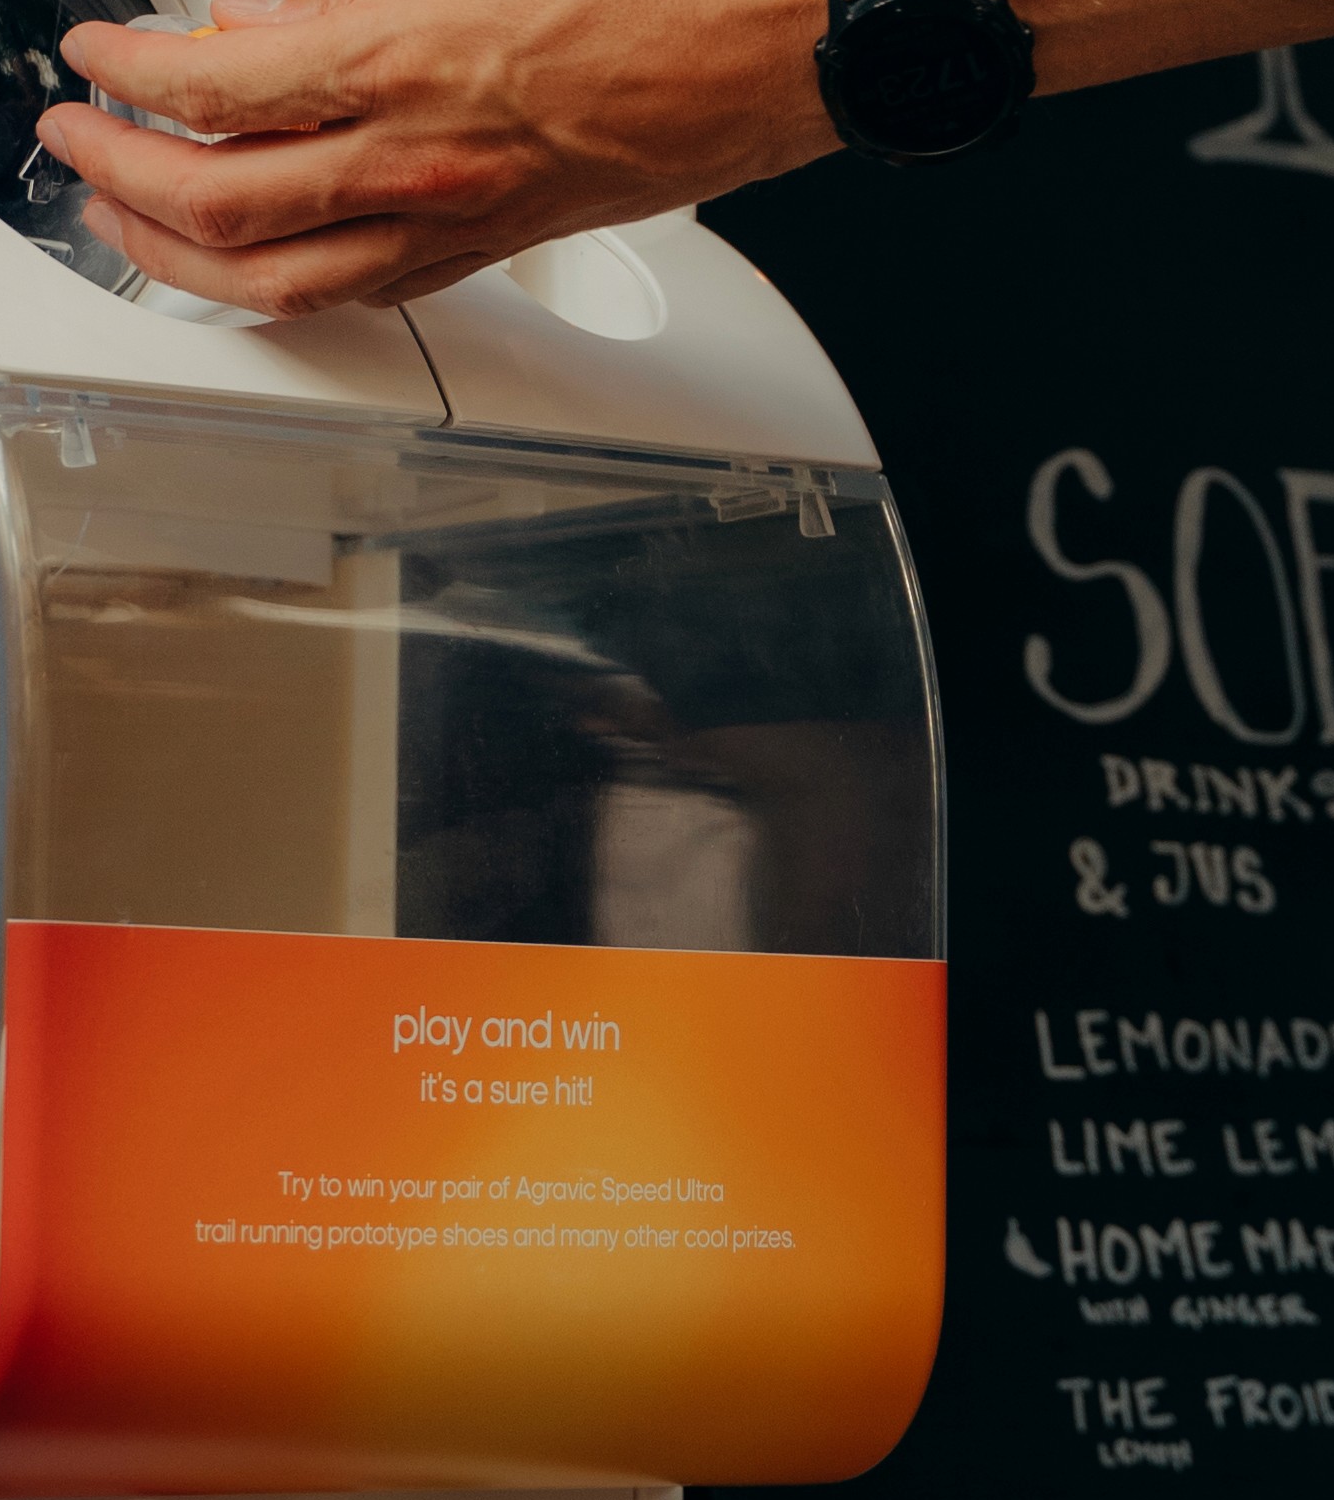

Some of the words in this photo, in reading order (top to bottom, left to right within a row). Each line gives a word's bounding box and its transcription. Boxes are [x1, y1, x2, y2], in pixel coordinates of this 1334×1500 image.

[1069, 836, 1131, 919] &
[1149, 840, 1277, 916] JUS
[393, 1005, 472, 1055] play
[482, 1010, 553, 1050] and
[561, 1012, 620, 1051] win
[420, 1071, 457, 1103] it's
[464, 1080, 482, 1104] a
[489, 1080, 549, 1106] sure
[555, 1076, 593, 1107] hit!
[1048, 1118, 1196, 1178] LIME
[278, 1171, 313, 1201] Try
[319, 1174, 341, 1198] to
[348, 1174, 384, 1199] win
[389, 1179, 436, 1203] your
[442, 1176, 483, 1204] pair
[489, 1176, 511, 1200] of
[515, 1176, 595, 1205] Agravic
[601, 1177, 671, 1206] Speed
[676, 1178, 724, 1203] Ultra
[195, 1219, 236, 1245] trail
[240, 1221, 322, 1250] running
[327, 1223, 437, 1252] prototype
[443, 1222, 508, 1248] shoes
[513, 1223, 556, 1248] and
[561, 1227, 619, 1252] many
[624, 1224, 679, 1249] other
[684, 1225, 728, 1250] cool
[732, 1225, 796, 1254] prizes.
[1056, 1215, 1233, 1287] HOME
[1169, 1292, 1319, 1331] GINGER
[1056, 1375, 1177, 1434] THE
